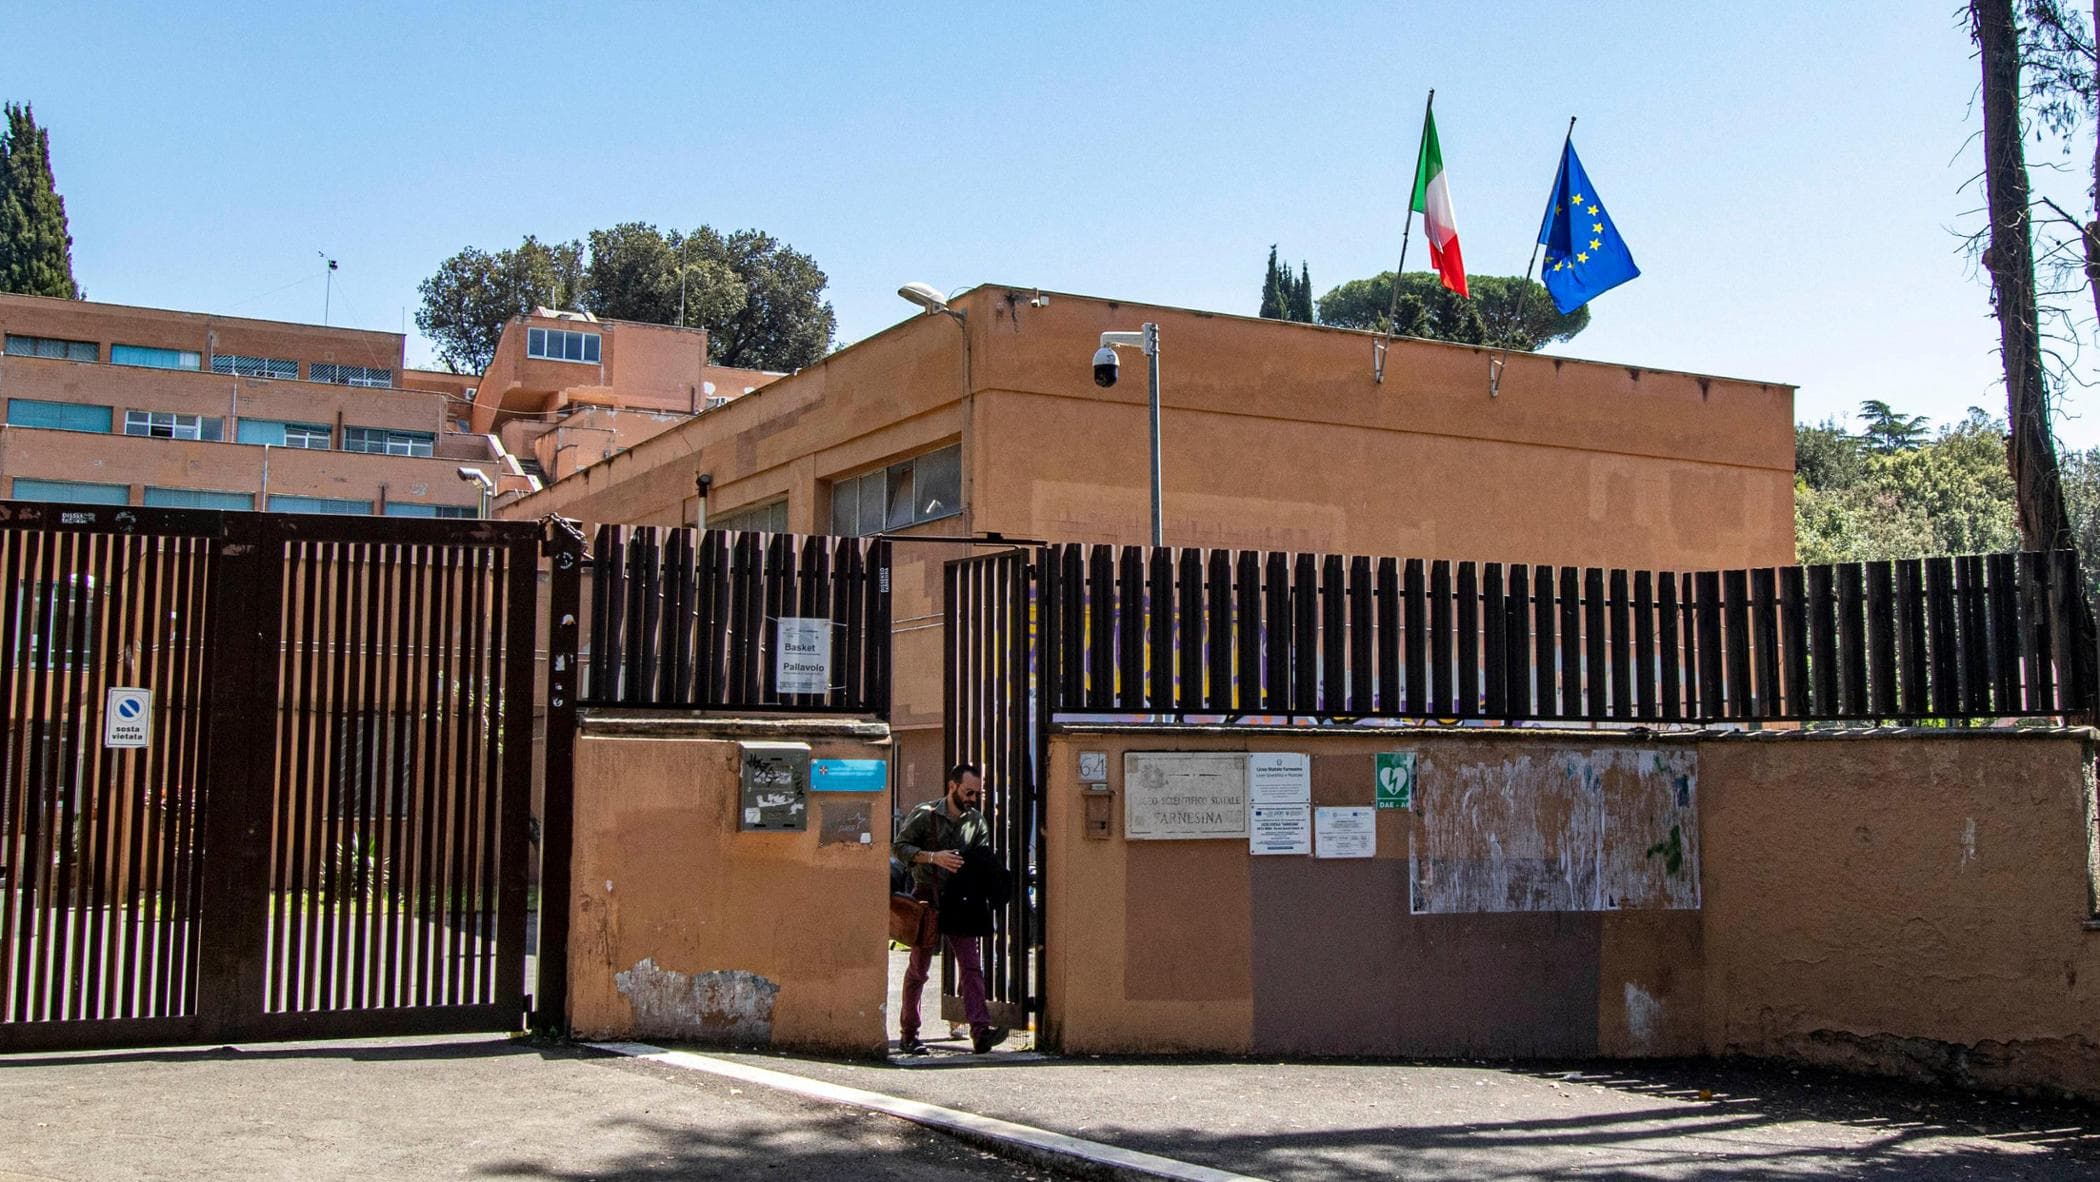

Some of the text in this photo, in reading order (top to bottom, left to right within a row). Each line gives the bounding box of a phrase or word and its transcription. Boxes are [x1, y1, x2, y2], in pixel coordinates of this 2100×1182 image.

[784, 643, 816, 652] Basket
[783, 662, 825, 672] Pallavolo
[1080, 754, 1105, 777] 64
[1210, 796, 1241, 805] STATALE
[1154, 811, 1223, 825] FARNESINA
